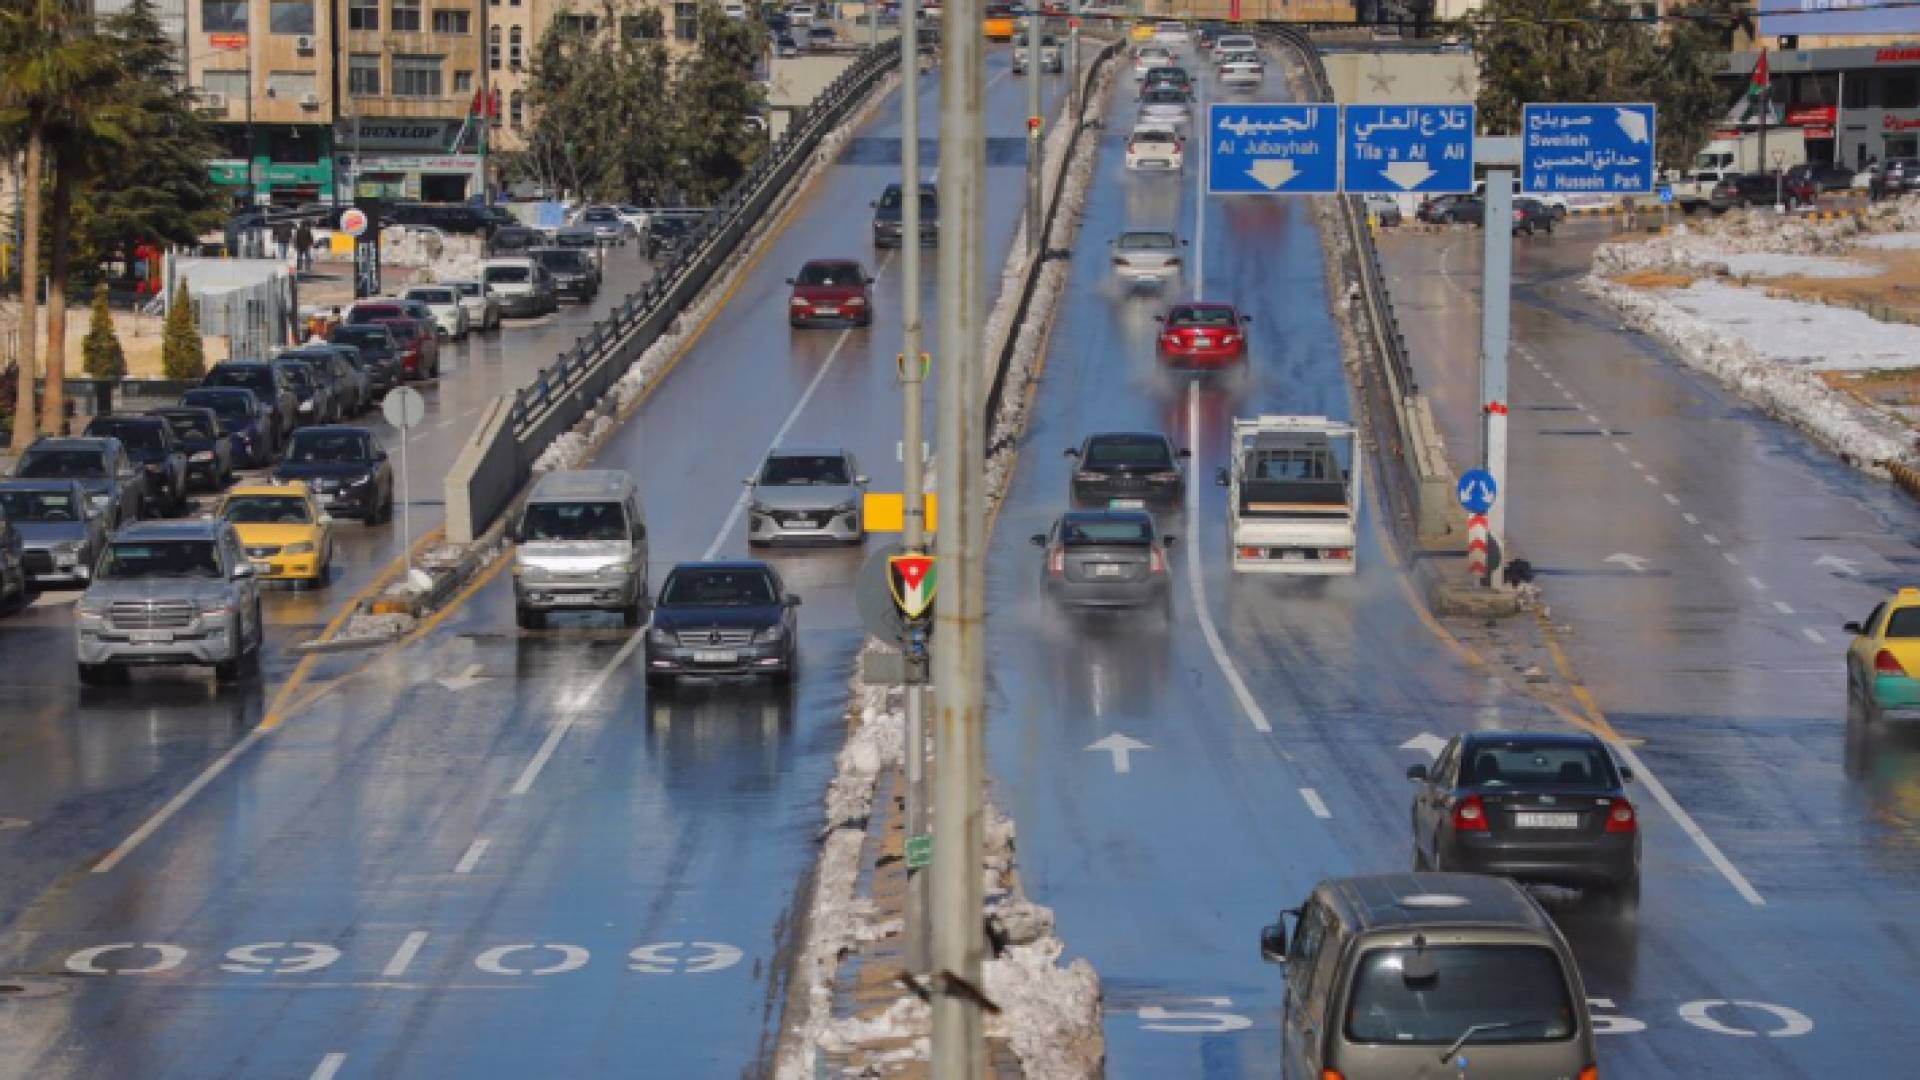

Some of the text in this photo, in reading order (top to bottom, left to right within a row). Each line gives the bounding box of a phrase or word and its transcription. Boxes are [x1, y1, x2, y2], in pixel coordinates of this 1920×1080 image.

[360, 125, 439, 138] DUNLOP
[1354, 107, 1466, 141] تلاع العلي
[1217, 139, 1320, 158] Al Jubayhah
[1530, 132, 1588, 147] Sweileh
[1408, 142, 1427, 160] Al
[1443, 142, 1465, 160] Ali
[1533, 149, 1641, 171] حدائق الحسين
[1533, 173, 1641, 189] Al Hussein Park
